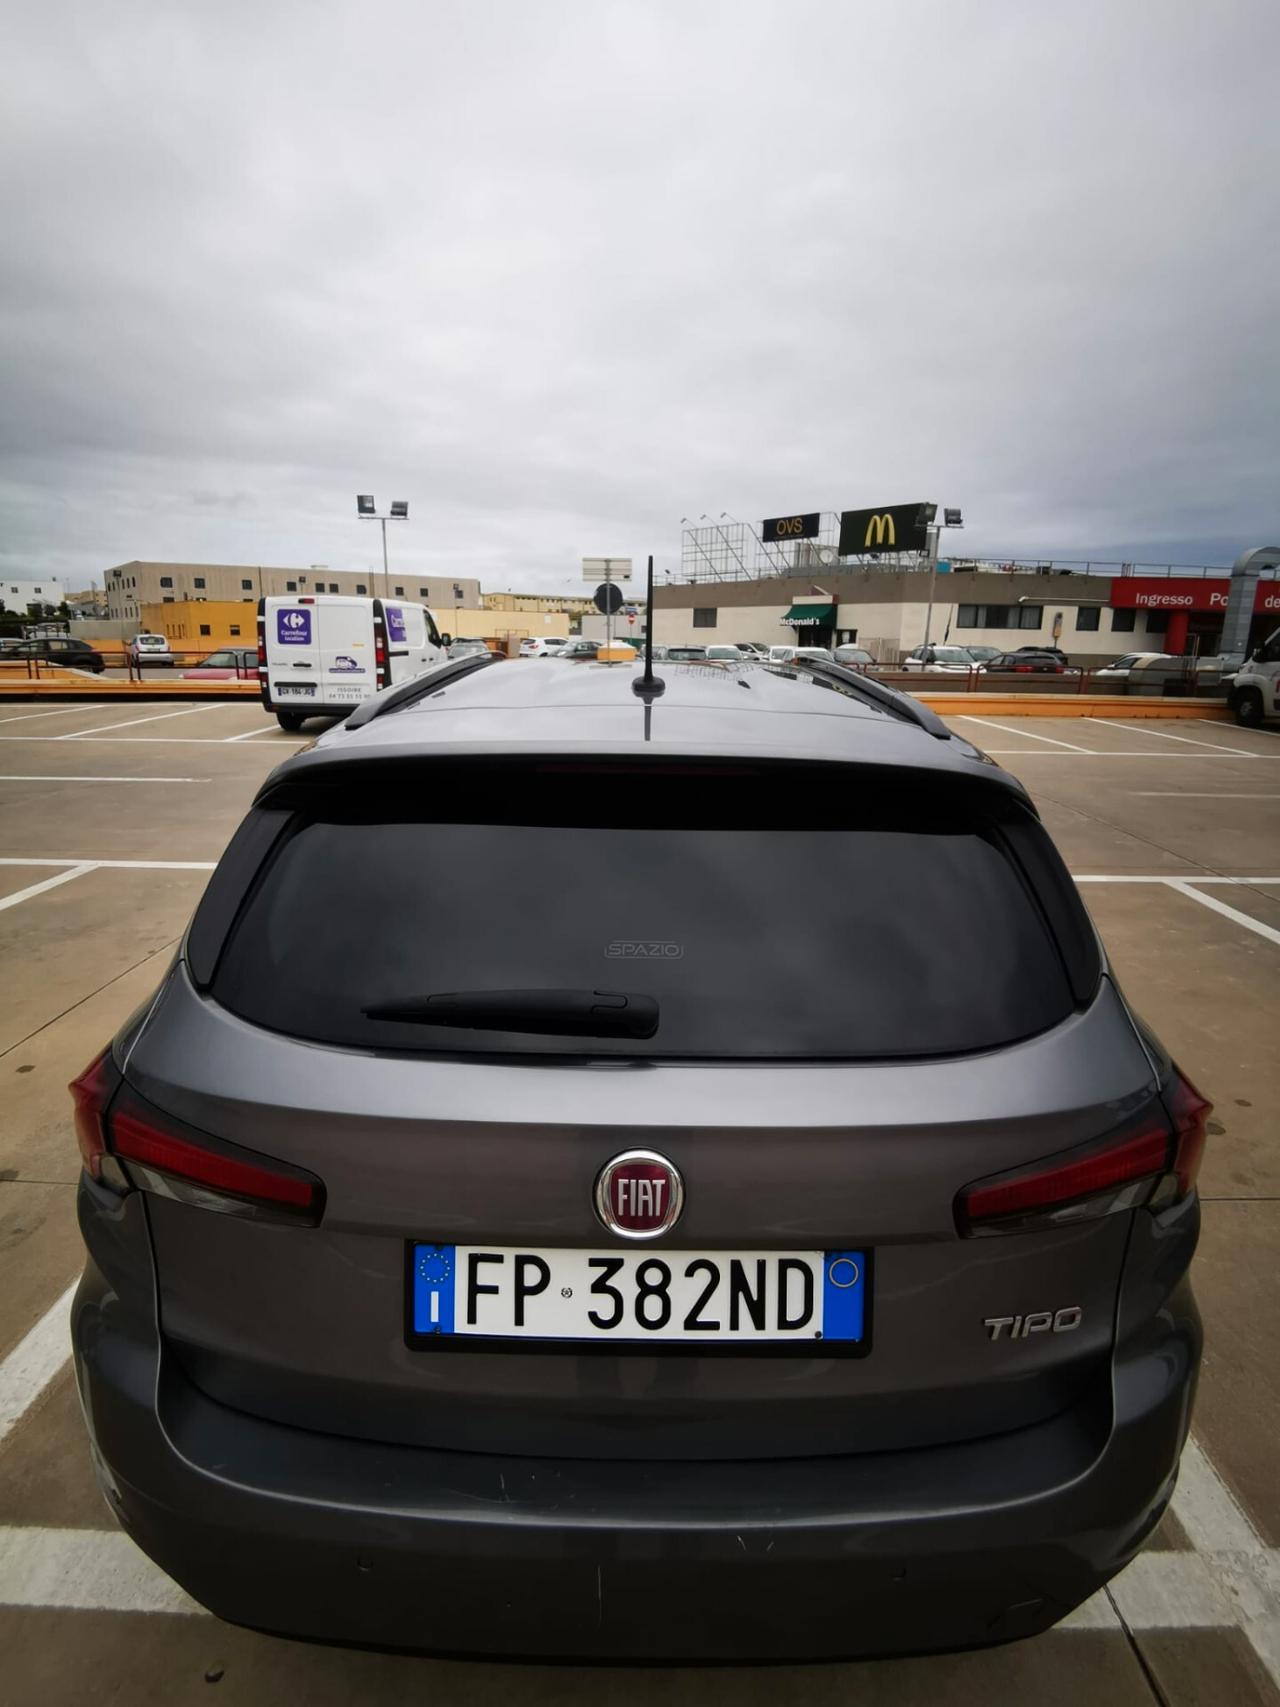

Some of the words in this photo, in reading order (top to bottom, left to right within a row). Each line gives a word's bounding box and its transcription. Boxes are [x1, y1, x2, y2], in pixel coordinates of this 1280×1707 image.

[776, 518, 803, 536] OVS
[1135, 593, 1193, 607] Ingresso
[780, 617, 820, 626] McDonald's
[608, 943, 680, 957] SPAZIO
[617, 1178, 666, 1217] FIAT
[466, 1253, 551, 1327] FP
[587, 1257, 815, 1331] 382ND
[984, 1306, 1082, 1341] TIPO
